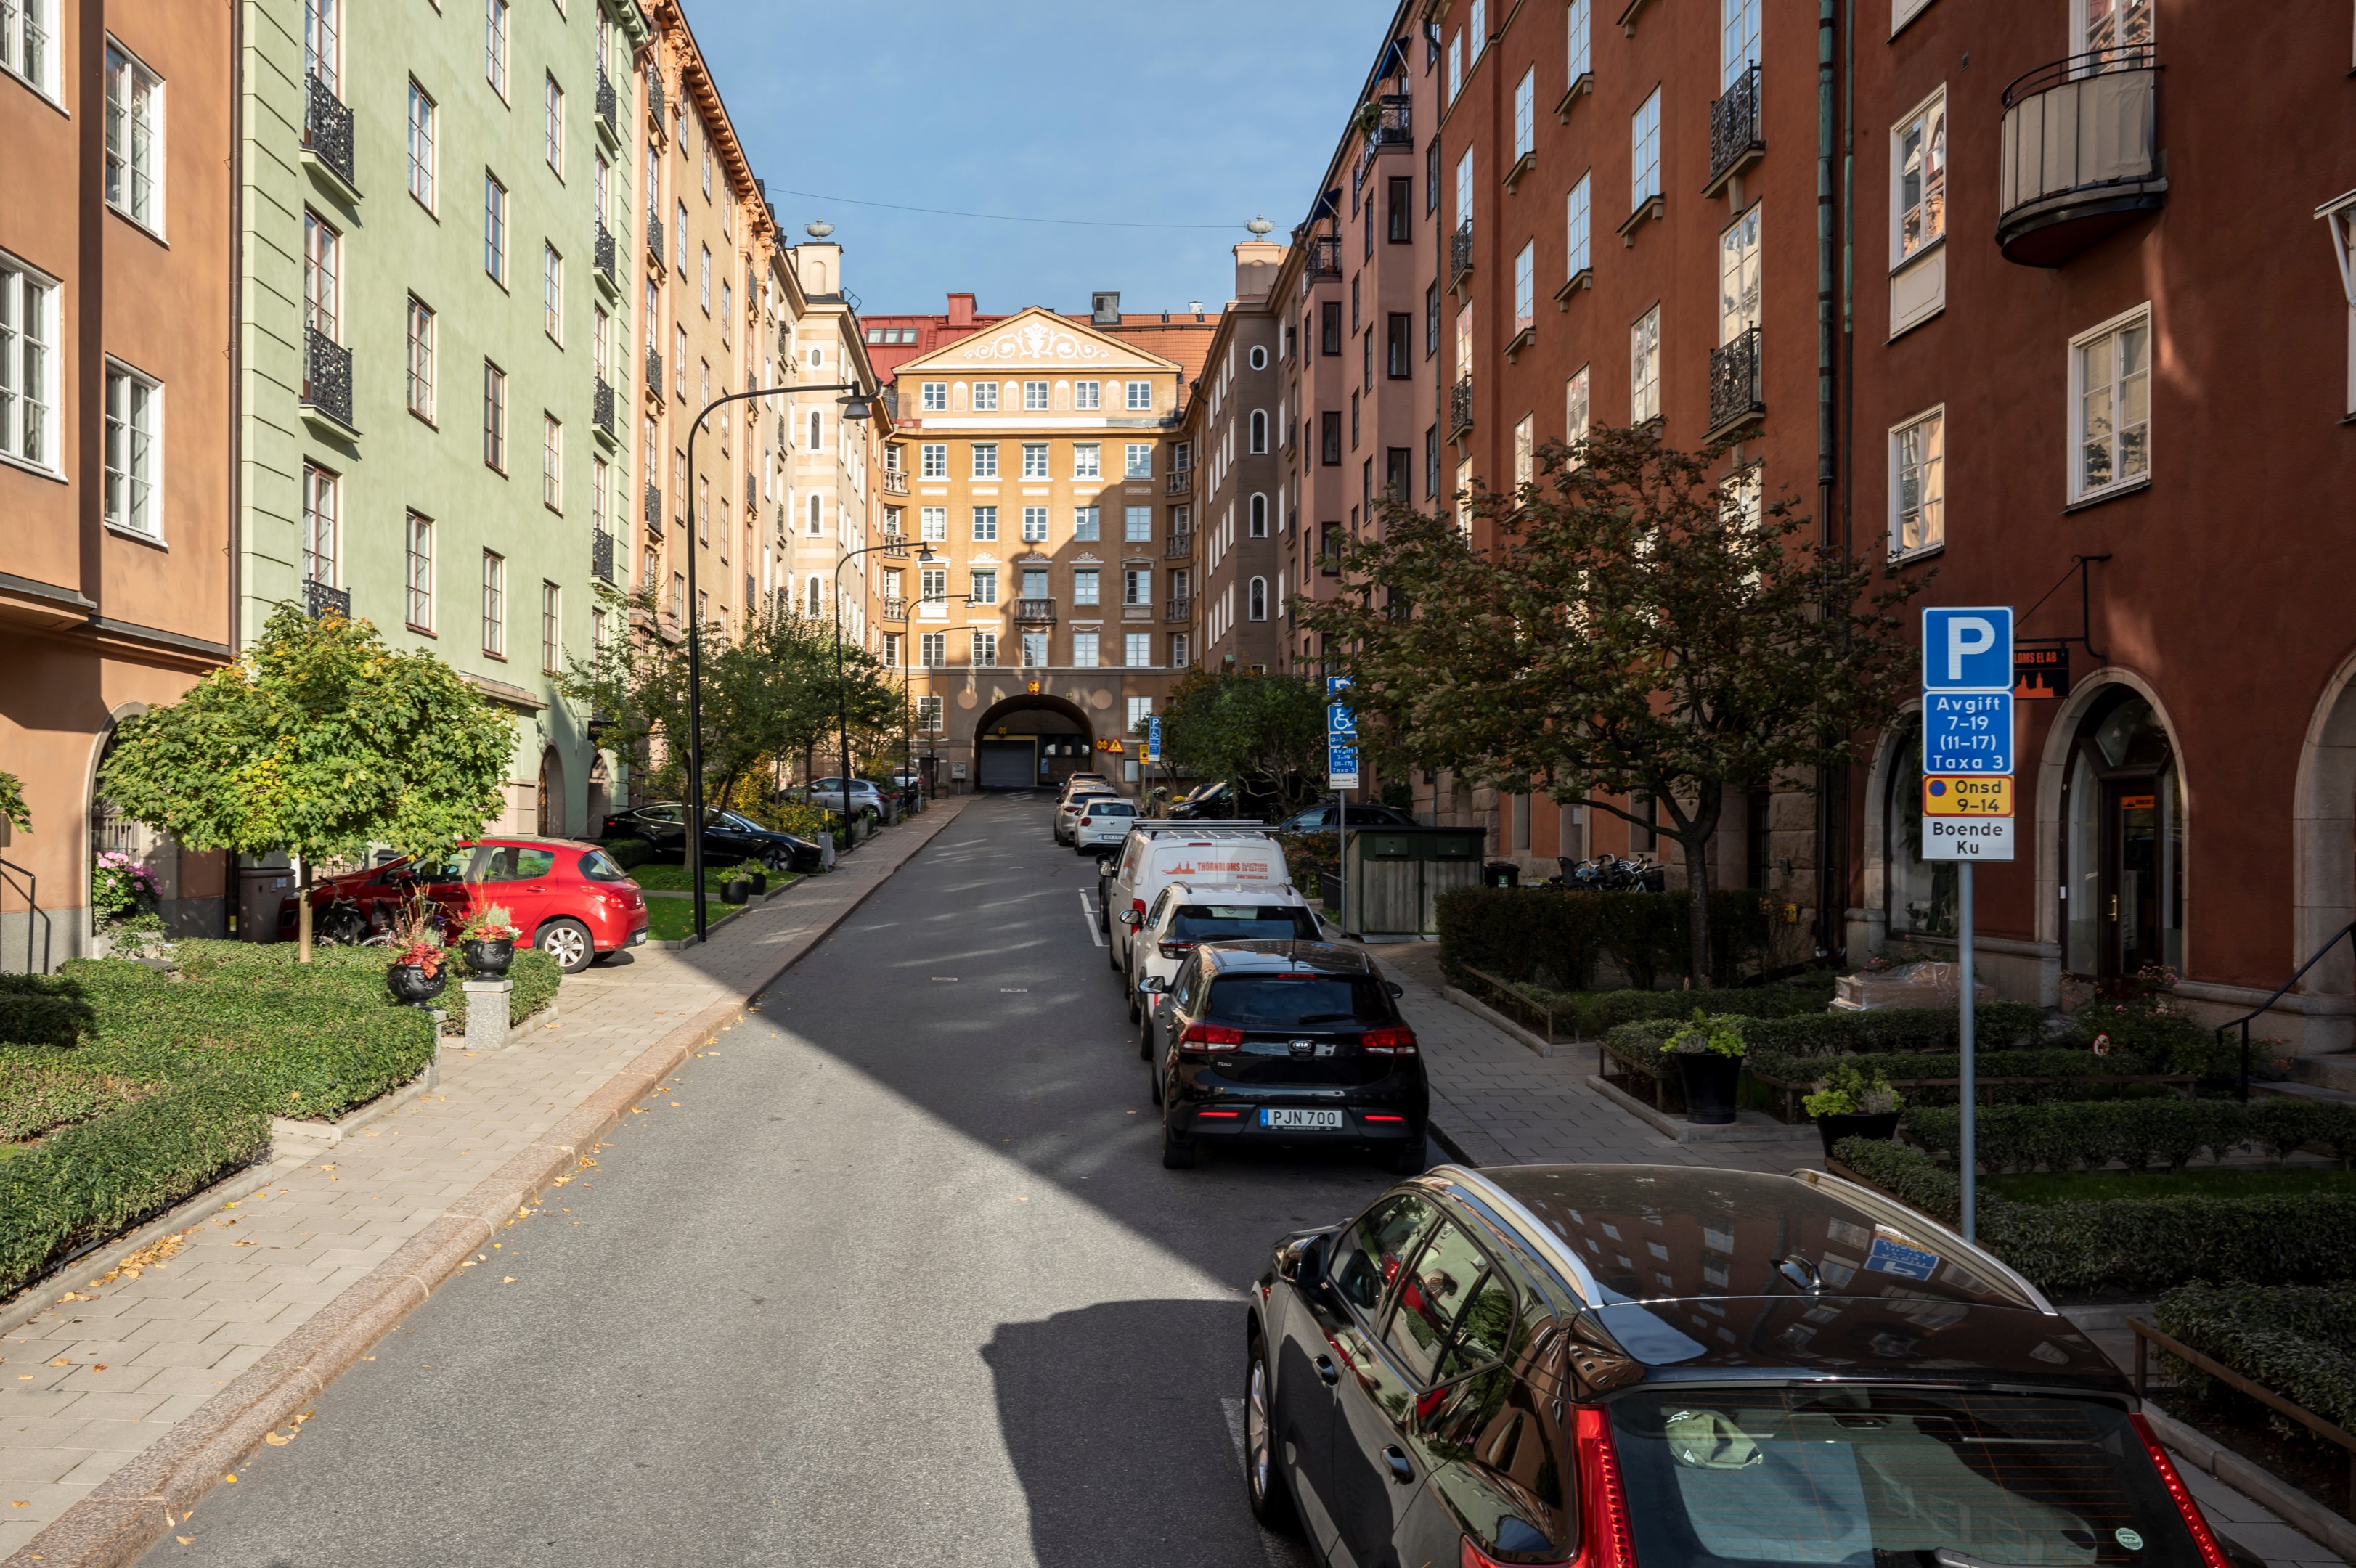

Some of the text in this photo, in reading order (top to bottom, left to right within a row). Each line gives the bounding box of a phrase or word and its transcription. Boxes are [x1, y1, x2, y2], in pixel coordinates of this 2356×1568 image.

[1947, 616, 1995, 680] P
[2014, 651, 2057, 663] LOMS EL AB
[1936, 697, 2000, 714] Avgift
[1152, 718, 1159, 727] P
[1947, 716, 1989, 730] 7-19
[1940, 735, 1997, 751] (11-17)
[1933, 755, 2004, 769] Taxa 3
[1955, 780, 2002, 794] Onsd
[1957, 799, 2000, 812] 9-14
[1933, 822, 2003, 837] Boende
[1957, 840, 1979, 854] Ku
[1197, 861, 1241, 872] THÖRNBLOMS
[1273, 1111, 1303, 1125] PJN
[1307, 1111, 1336, 1125] 700
